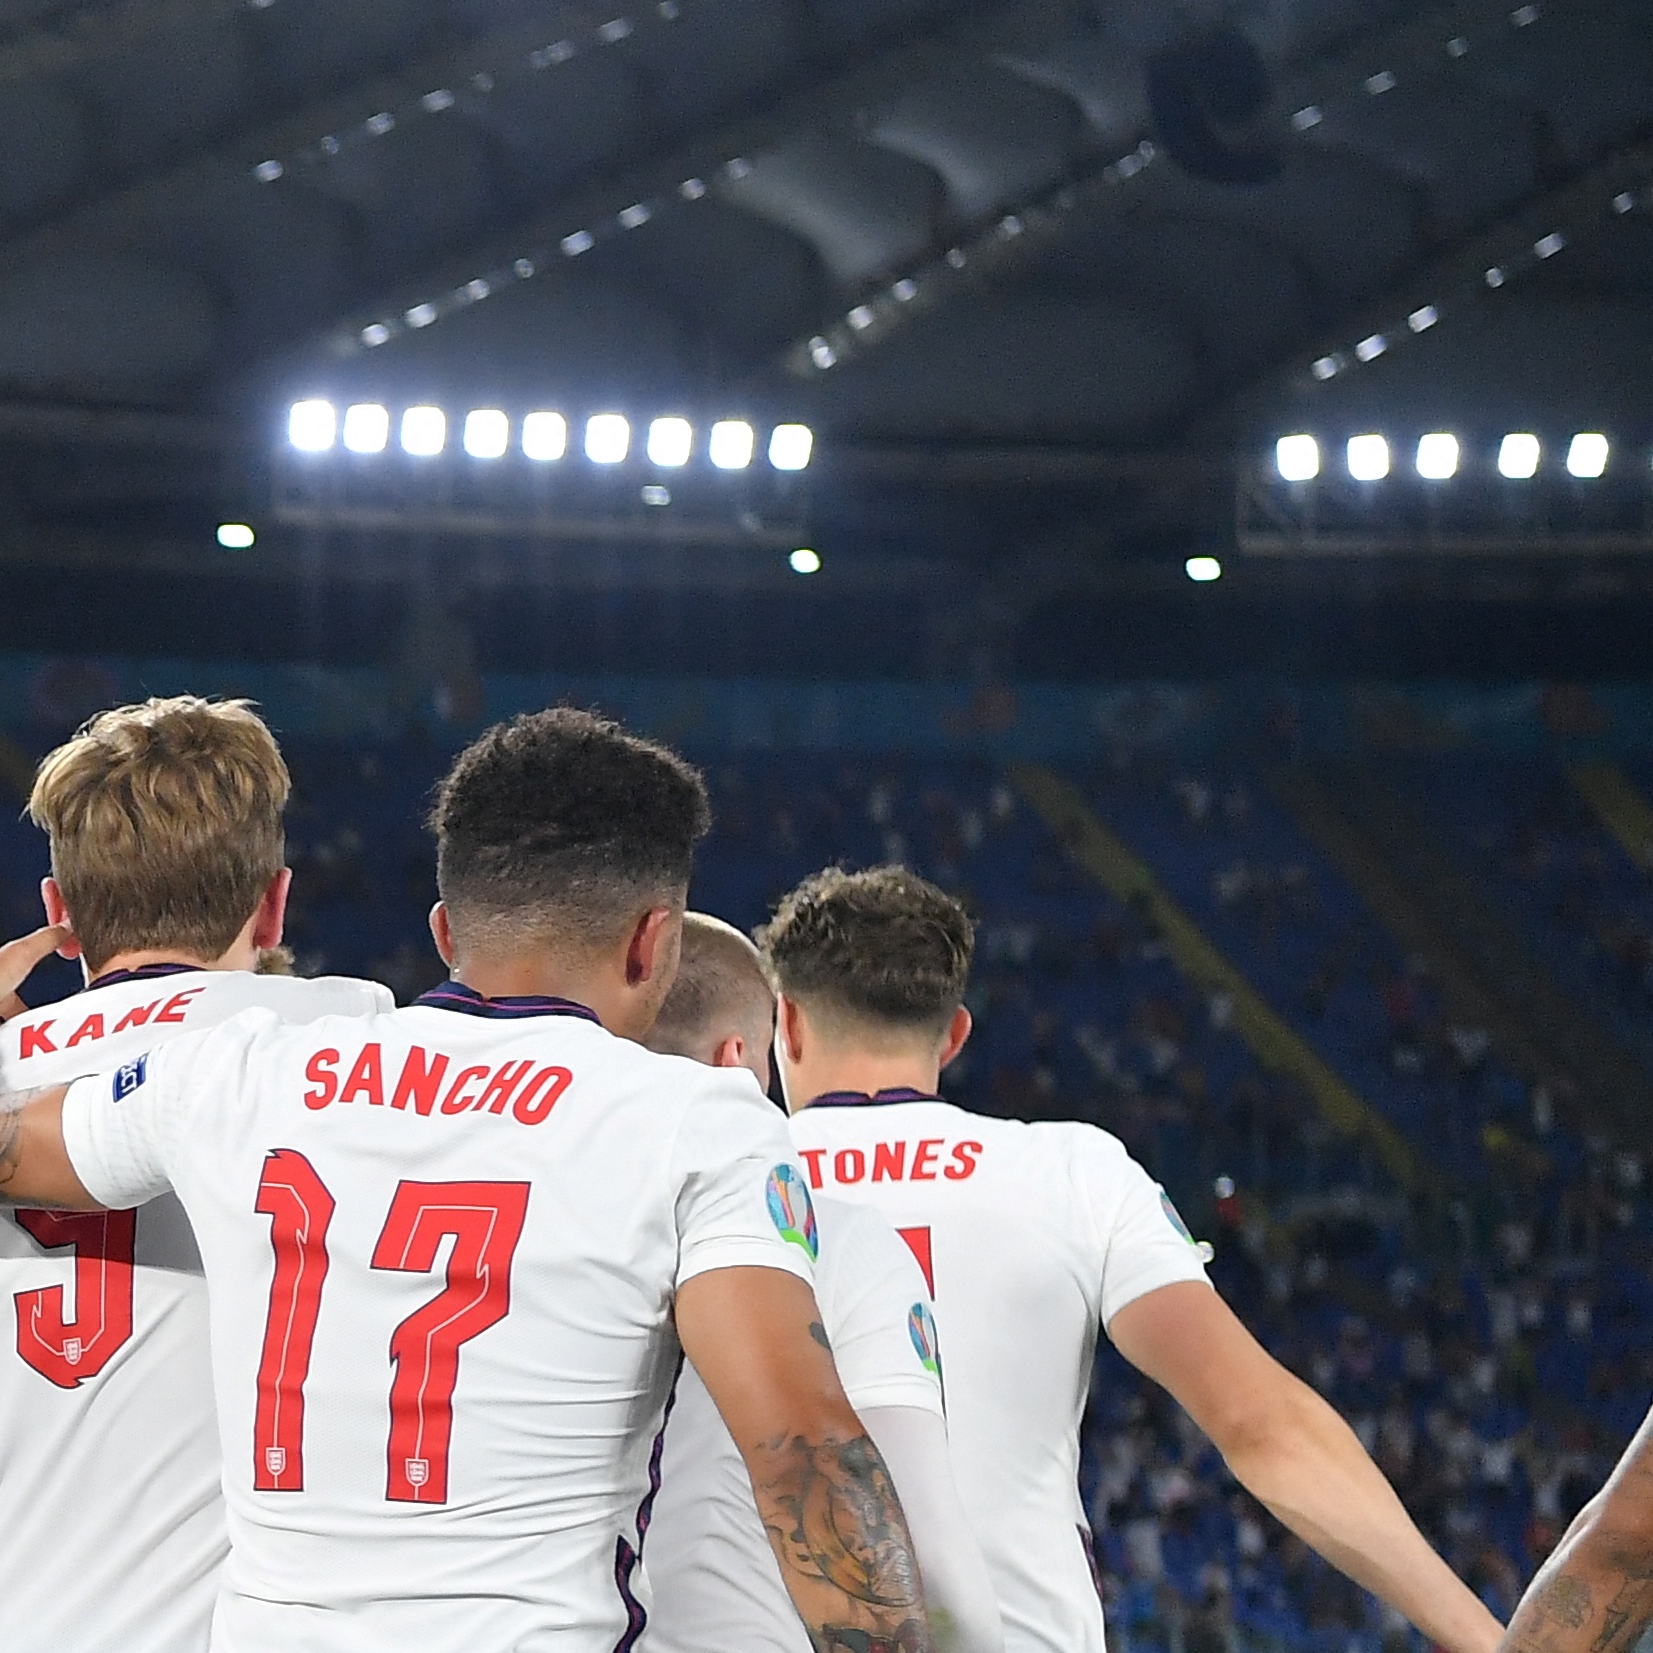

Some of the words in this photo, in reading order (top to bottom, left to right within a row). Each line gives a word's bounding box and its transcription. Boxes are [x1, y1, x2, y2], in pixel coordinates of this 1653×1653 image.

[19, 987, 206, 1060] KANE
[303, 1043, 575, 1126] SANCHO
[252, 1148, 532, 1505] 17
